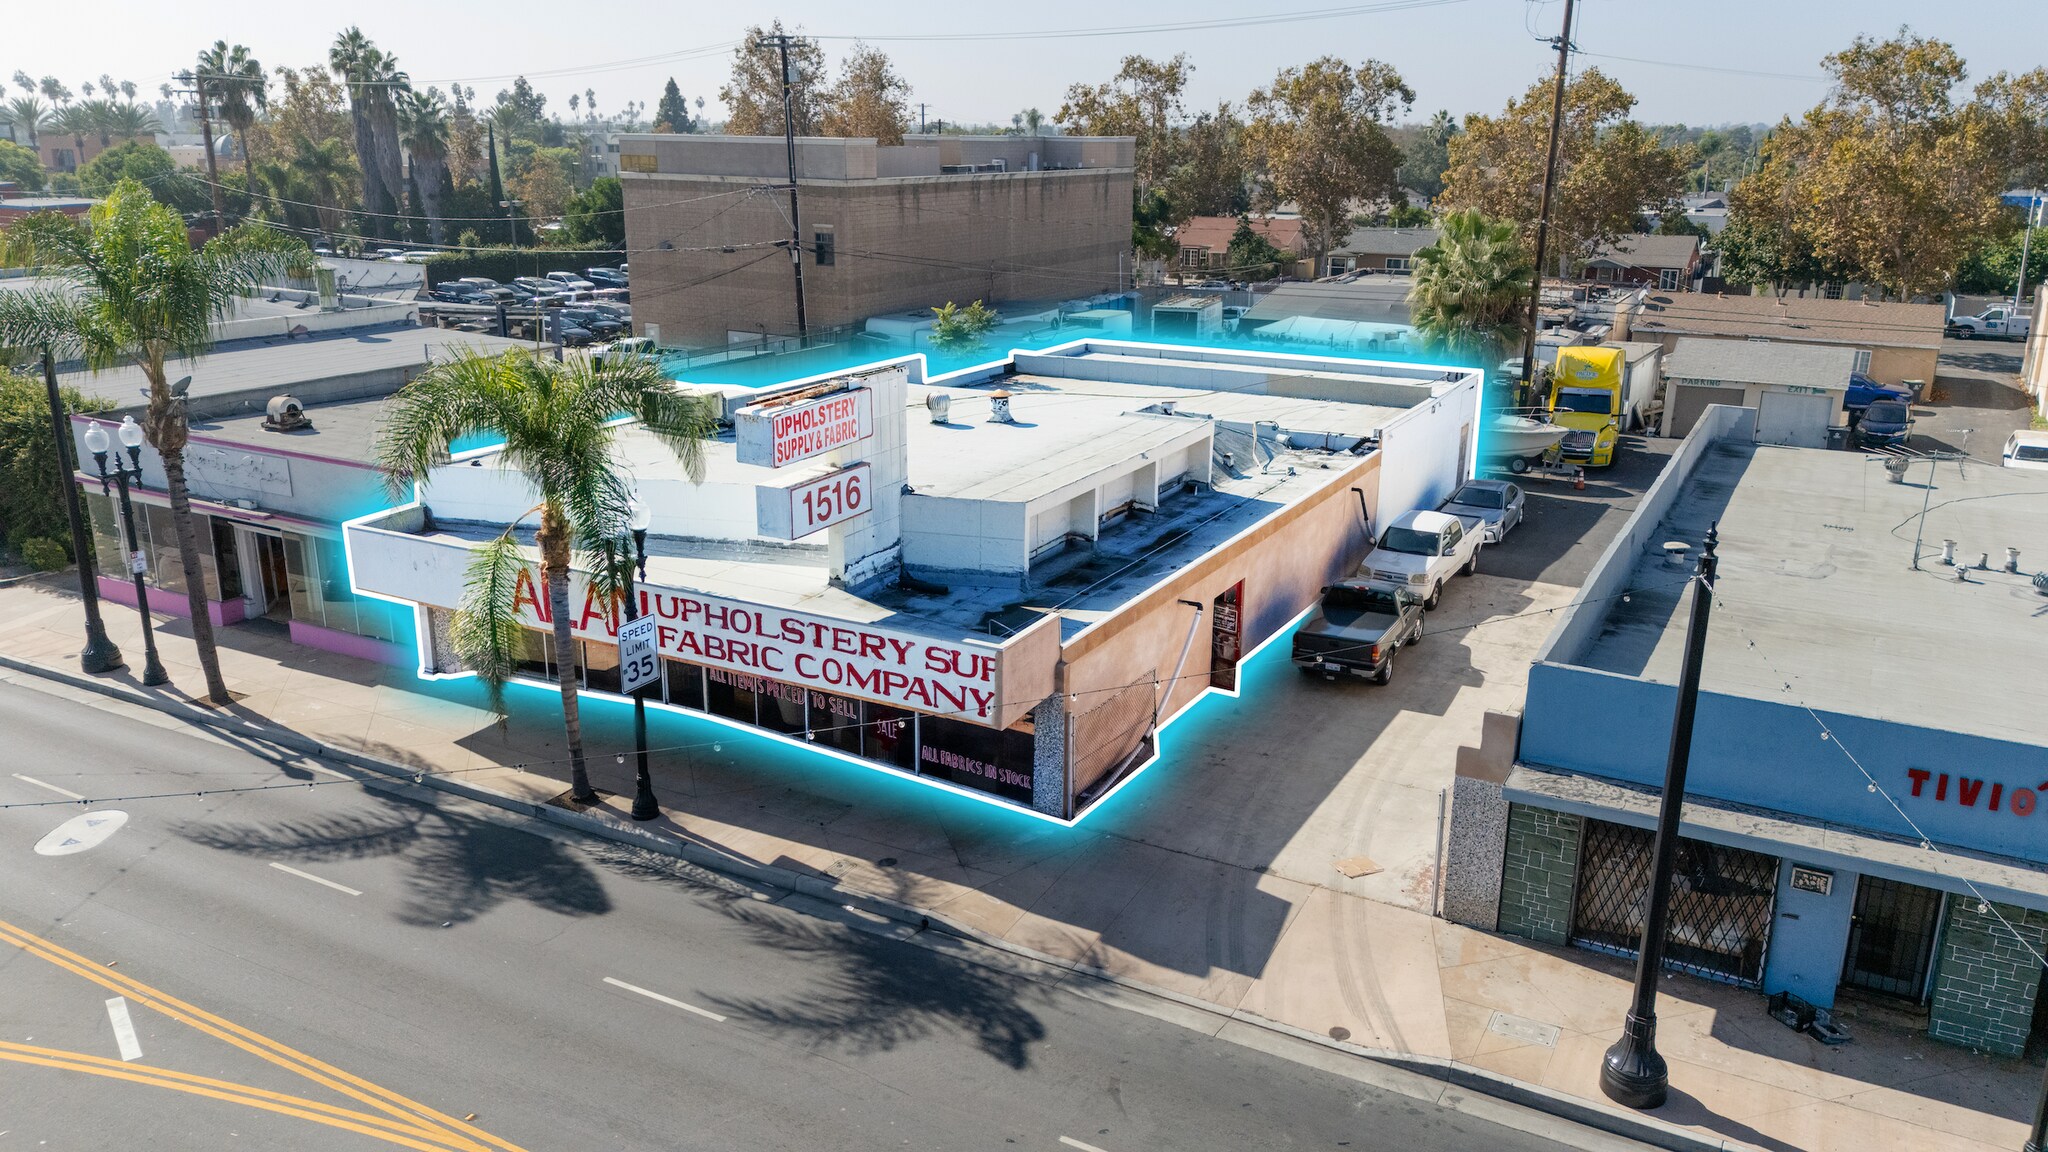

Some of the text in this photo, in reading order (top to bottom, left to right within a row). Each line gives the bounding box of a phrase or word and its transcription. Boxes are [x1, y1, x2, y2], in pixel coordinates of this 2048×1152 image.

[1681, 377, 1720, 387] PARKING
[1787, 385, 1808, 394] EXIT
[775, 396, 857, 439] UPHOLSTERY
[777, 418, 857, 463] SUPPLY & FABRIC
[803, 475, 861, 526] 1516
[622, 622, 653, 642] SPEED
[626, 638, 650, 656] LIMIT
[655, 593, 915, 665] UPHOLSTERY
[627, 654, 654, 683] 35
[657, 625, 995, 718] FABRIC COMPANY
[709, 668, 727, 683] ALL
[766, 677, 805, 705] PRICED
[811, 691, 825, 710] TO
[829, 696, 857, 720] SELL
[876, 718, 898, 739] SALE
[921, 745, 1032, 790] ALL FABRICS IN STOCK
